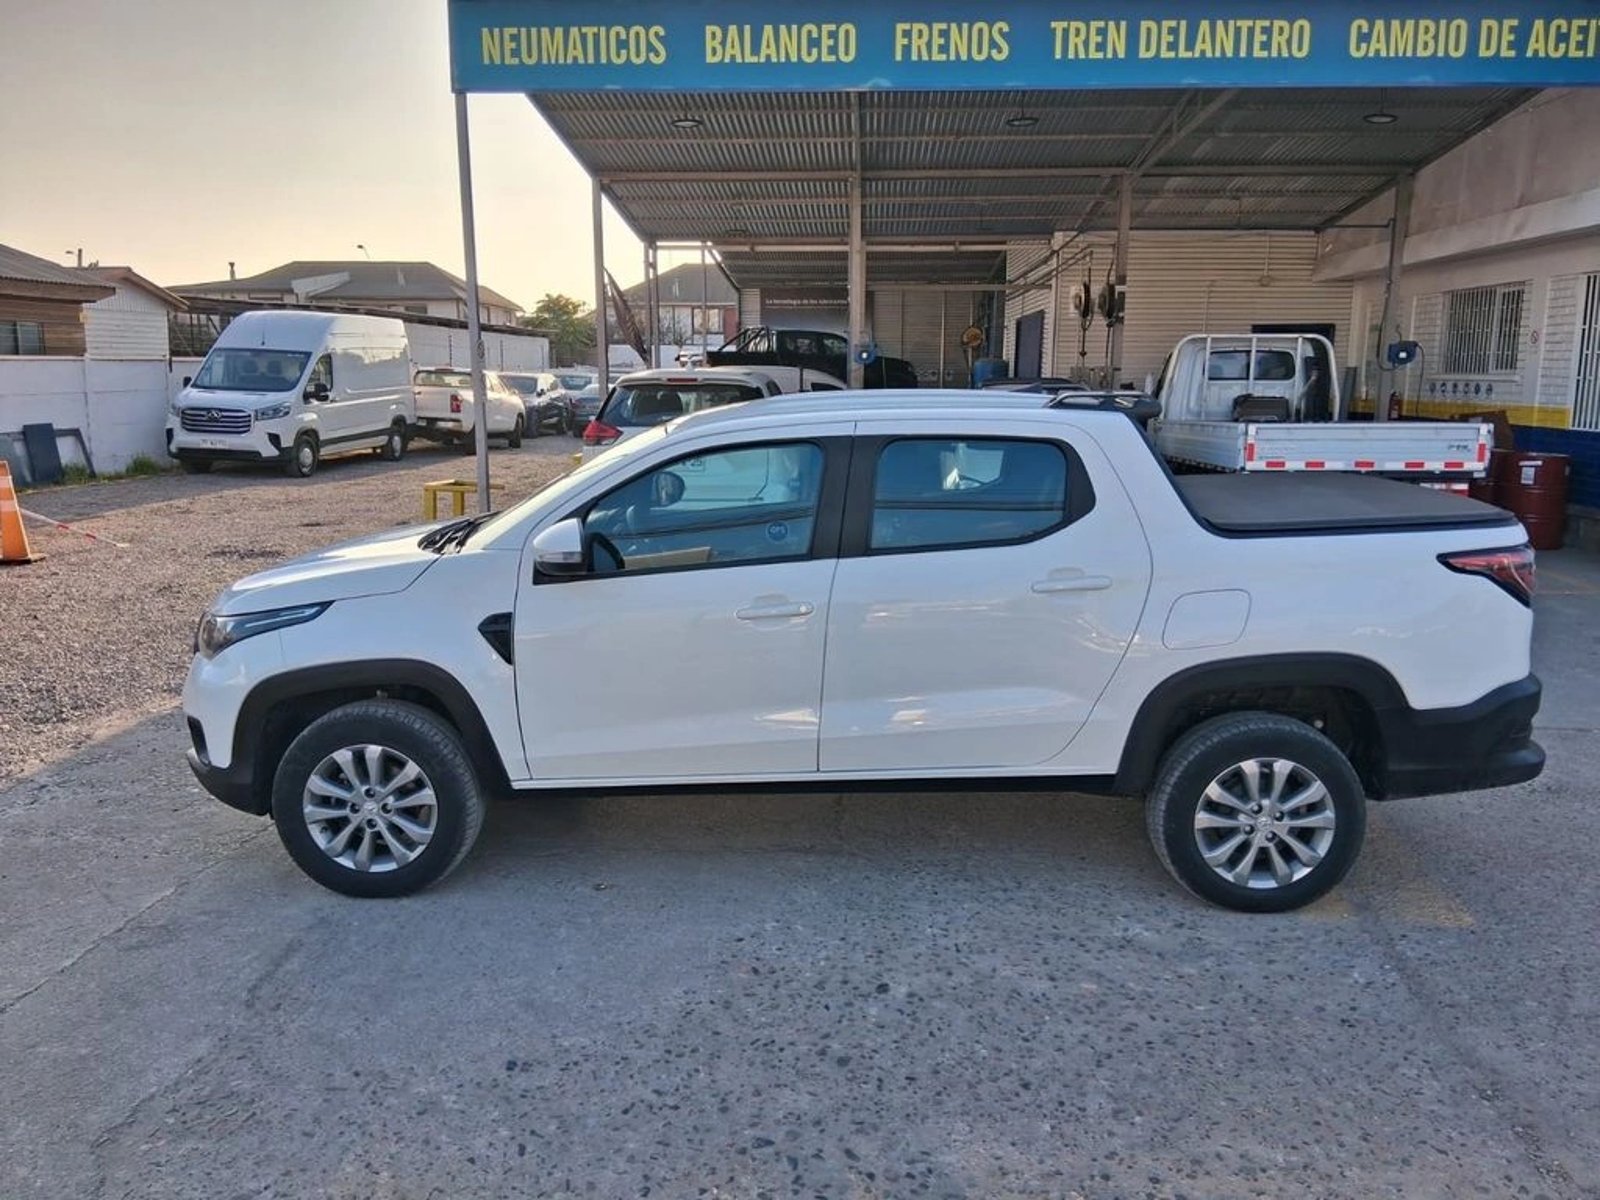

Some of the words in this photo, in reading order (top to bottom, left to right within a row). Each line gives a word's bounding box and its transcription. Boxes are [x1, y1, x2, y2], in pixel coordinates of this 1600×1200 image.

[481, 26, 667, 64] NEUMATICOS
[705, 24, 857, 62] BALANCEO
[895, 21, 1010, 60] FRENOS
[1051, 20, 1127, 58] TREN
[1139, 19, 1310, 58] DELANTERO
[1349, 19, 1467, 57] CAMBIO
[1478, 19, 1518, 57] DE
